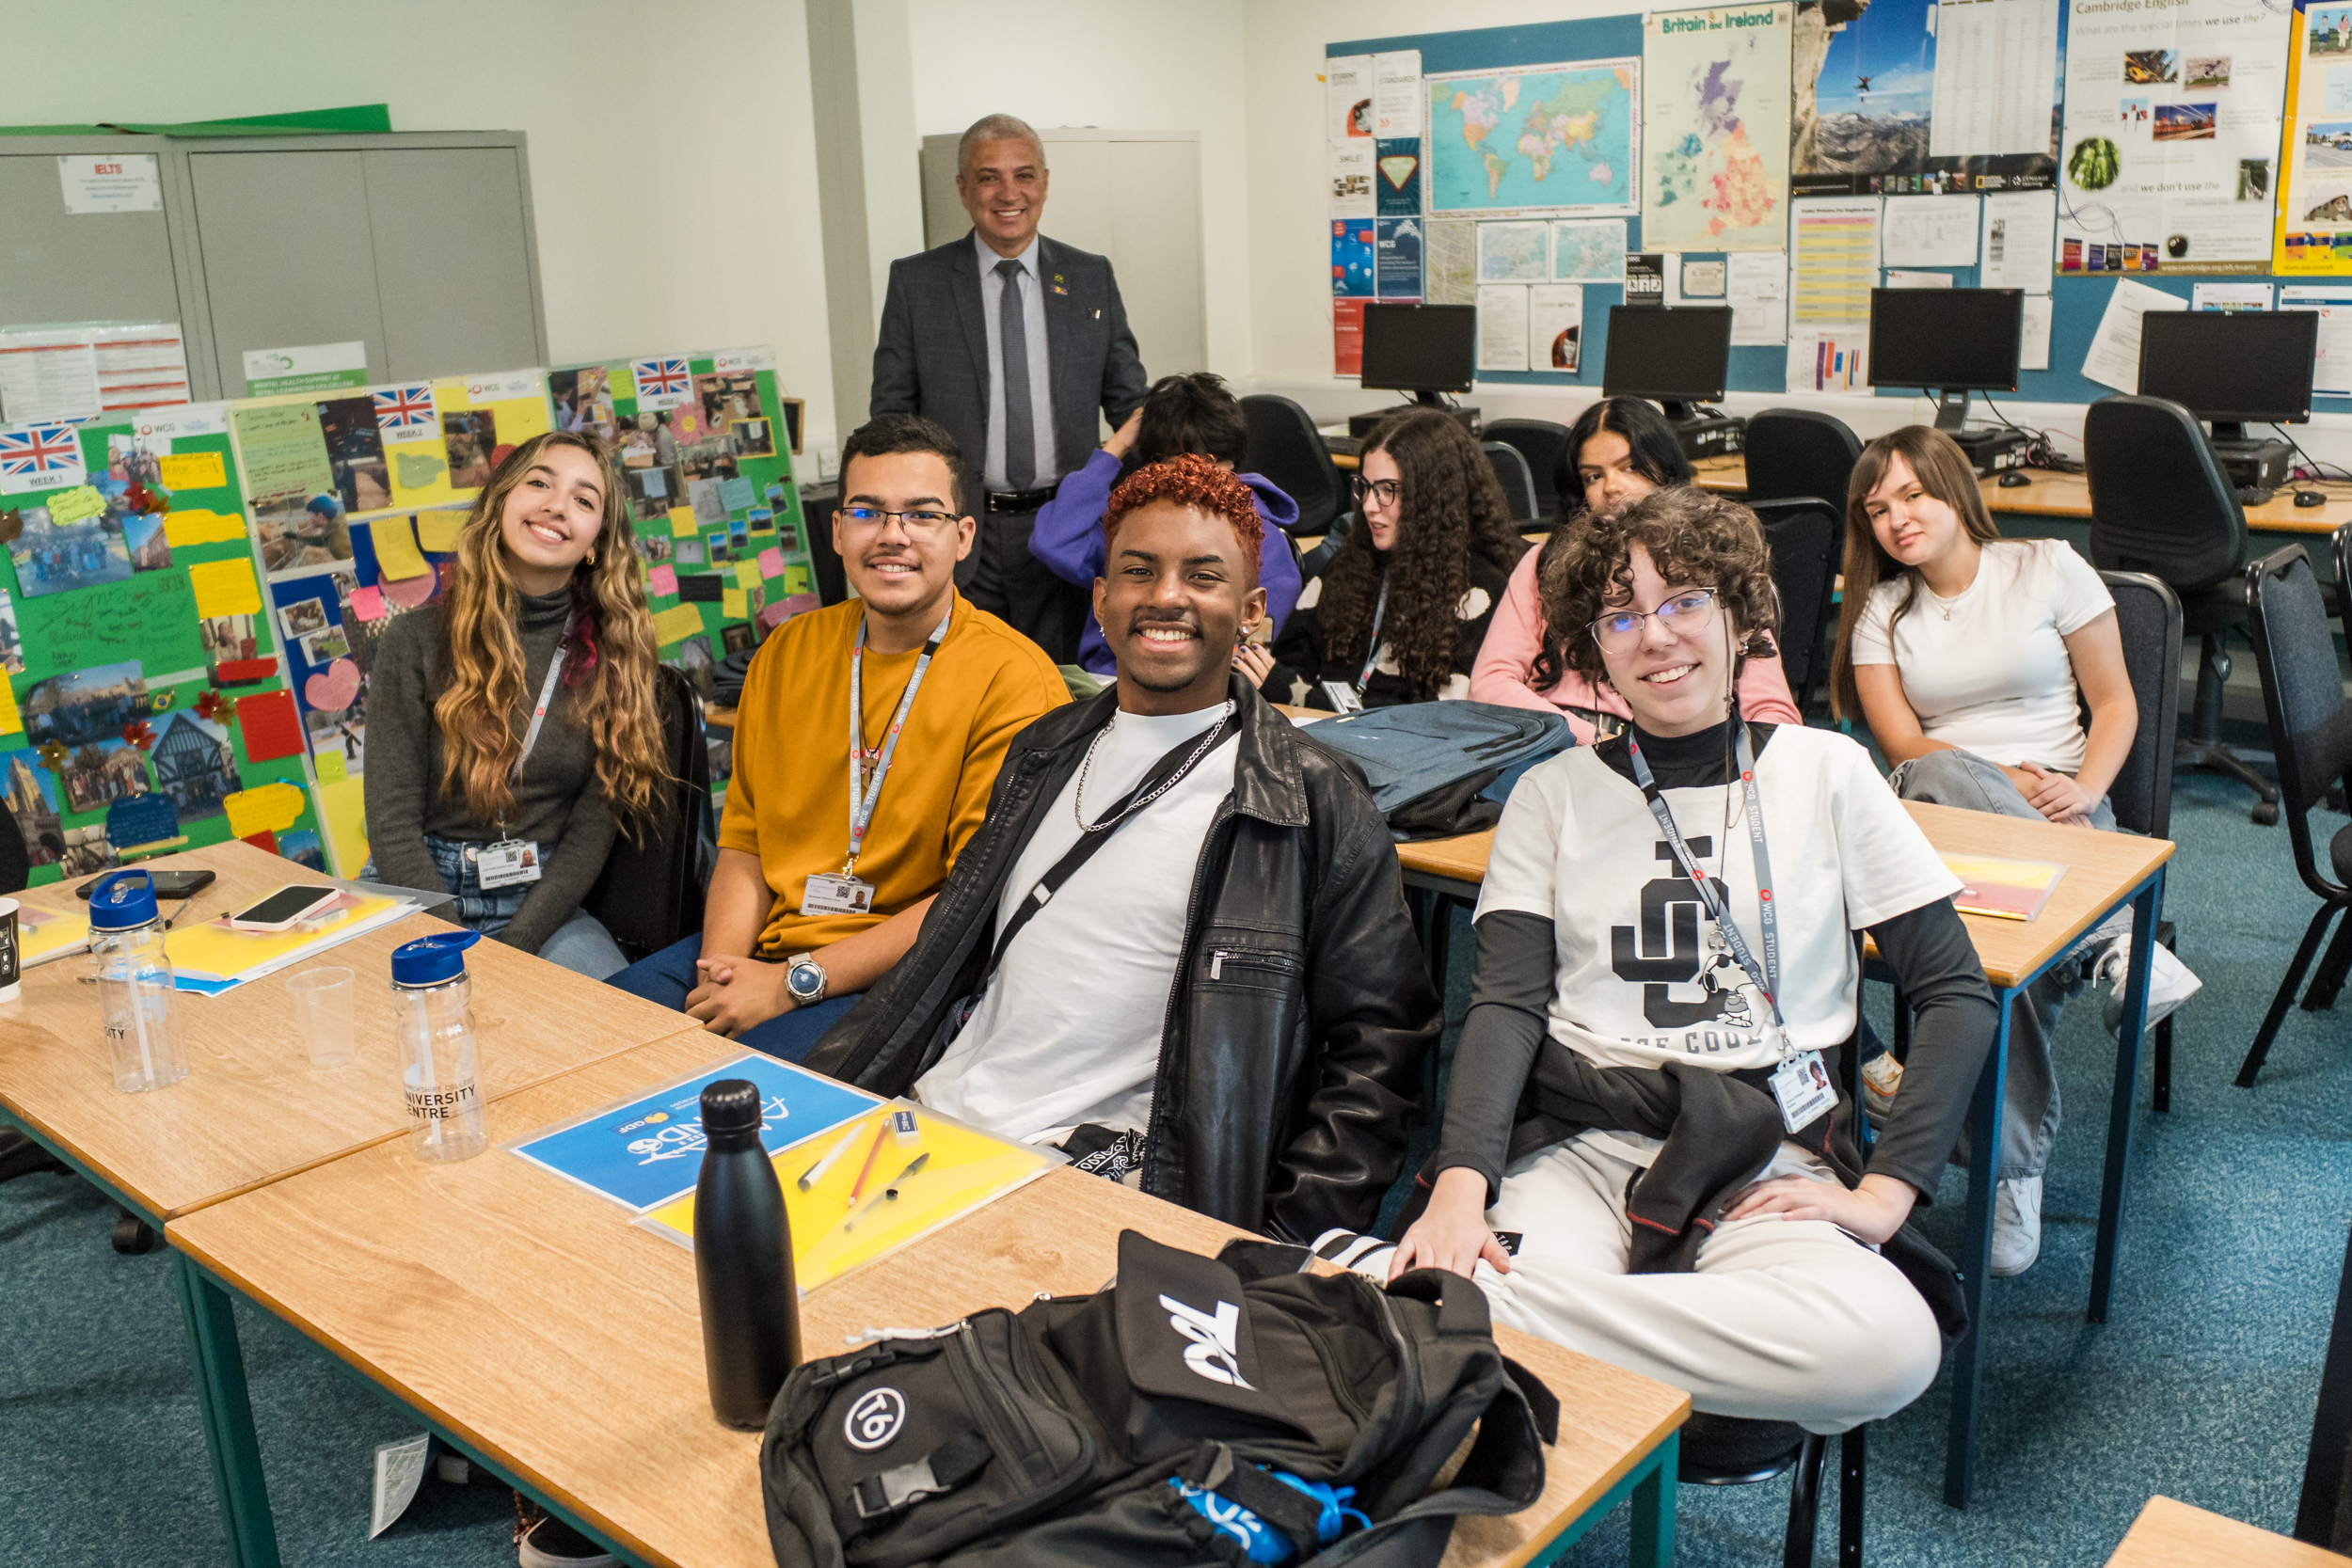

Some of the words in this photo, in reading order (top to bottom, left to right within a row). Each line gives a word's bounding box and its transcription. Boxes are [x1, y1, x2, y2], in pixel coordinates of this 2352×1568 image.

[2075, 1, 2142, 14] Cambridge
[1662, 15, 1707, 34] Britain
[1725, 8, 1773, 28] Ireland
[2075, 25, 2102, 36] What
[2122, 23, 2137, 33] the
[2139, 20, 2173, 33] special
[2176, 19, 2202, 29] times
[2204, 18, 2220, 26] we
[2222, 16, 2241, 25] use
[2243, 13, 2266, 24] the?
[94, 164, 123, 175] IELTS
[2121, 182, 2138, 193] and
[2140, 184, 2155, 193] we
[2157, 182, 2183, 192] don't
[2185, 182, 2202, 191] use
[2204, 182, 2220, 190] the
[154, 422, 176, 433] WCG
[395, 429, 417, 439] WEEK
[29, 475, 56, 485] WEEK
[897, 707, 907, 723] WCG
[904, 668, 923, 703] STUDENT
[857, 810, 869, 827] WCG
[866, 769, 882, 806] STUDENT
[1748, 805, 1764, 844] STUDENT
[1762, 902, 1773, 925] WCG
[1723, 923, 1753, 967] STUDENT
[1764, 932, 1777, 979] STUDENT
[1750, 971, 1766, 992] WCG
[405, 1084, 475, 1106] NIVERSITY
[407, 1103, 450, 1119] ENTRE
[619, 1120, 645, 1133] GDF
[856, 1393, 895, 1440] T6
